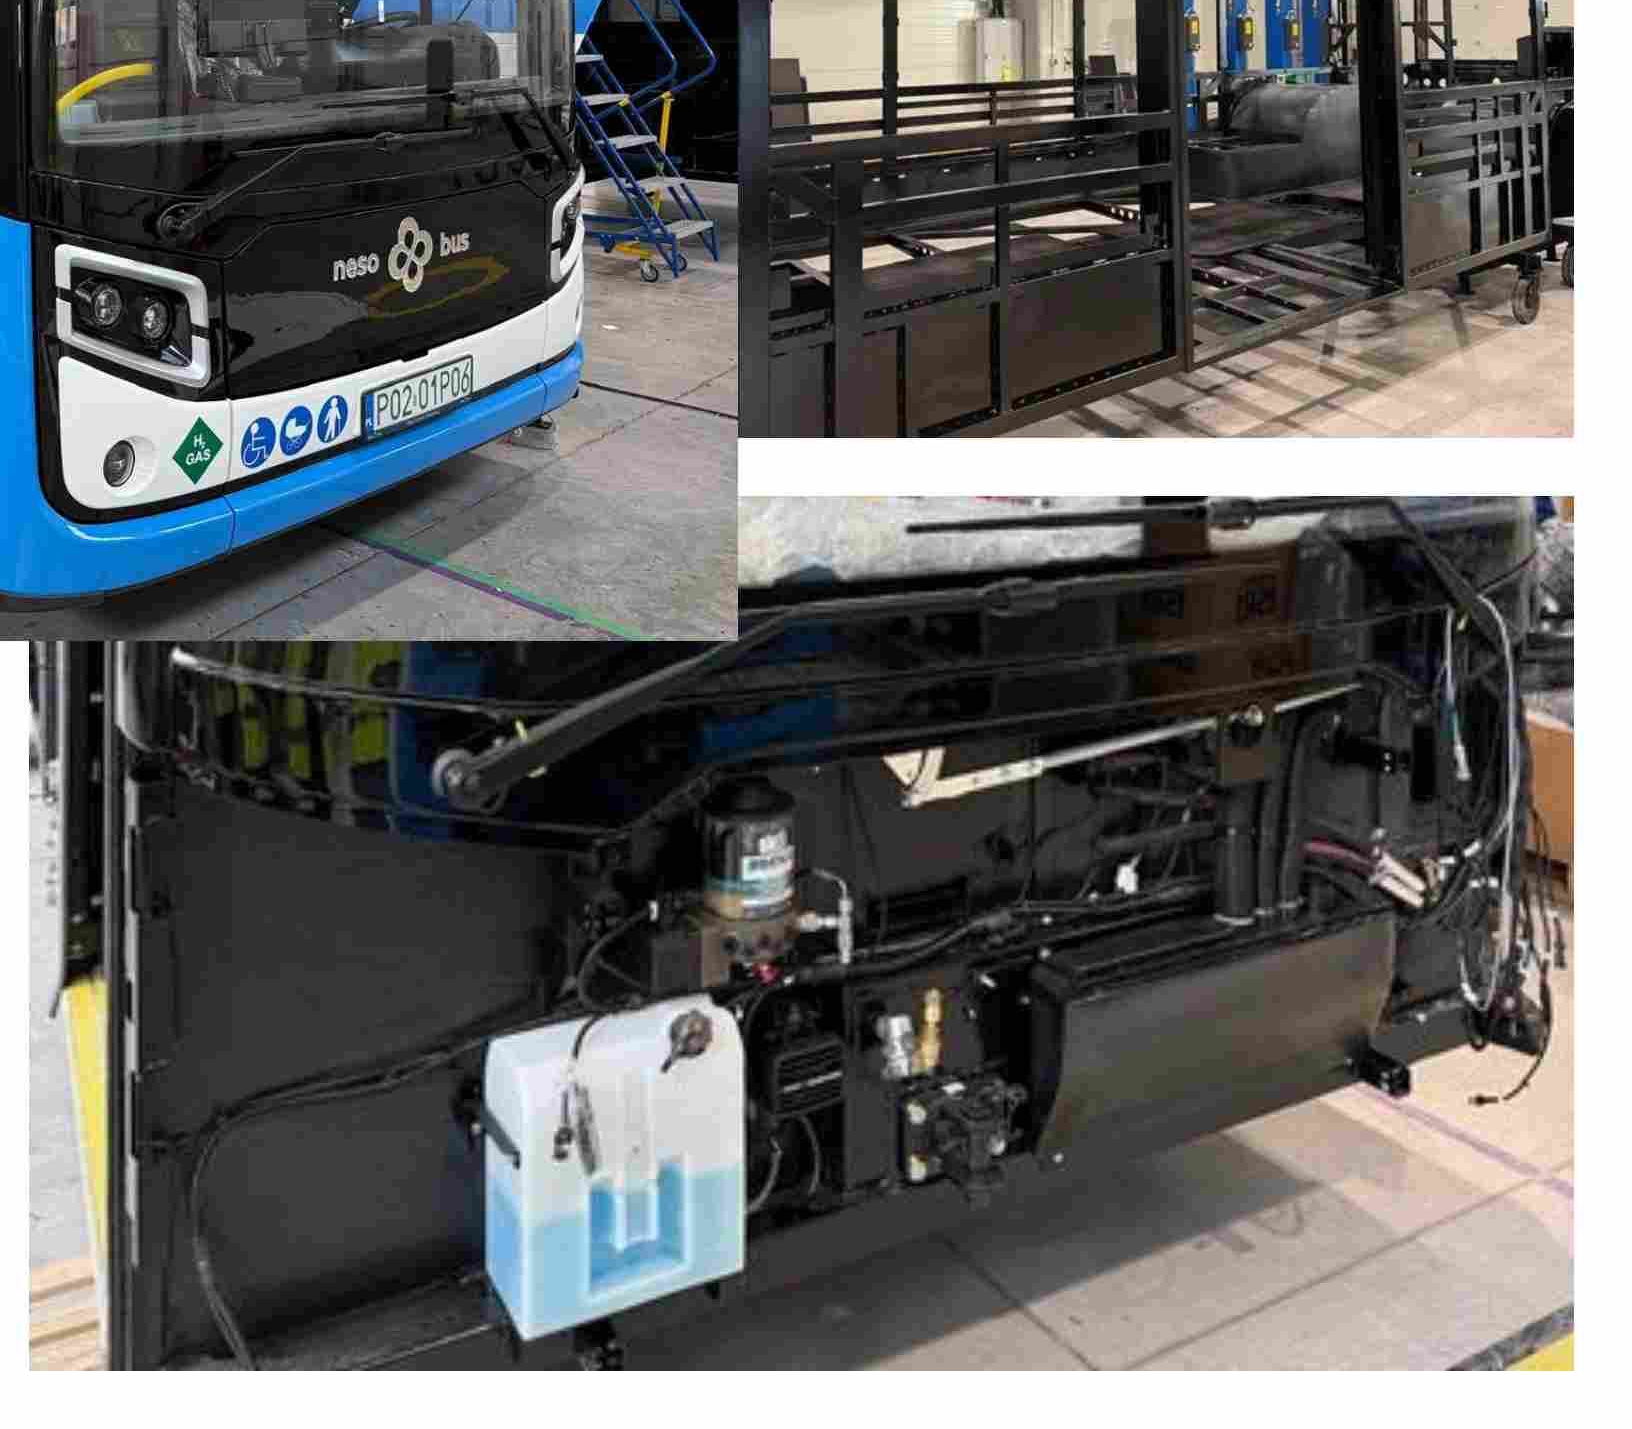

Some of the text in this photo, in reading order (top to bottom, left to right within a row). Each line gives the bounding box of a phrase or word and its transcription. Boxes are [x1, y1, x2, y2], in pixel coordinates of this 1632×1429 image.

[333, 231, 470, 282] neso bus
[185, 449, 211, 465] GAS
